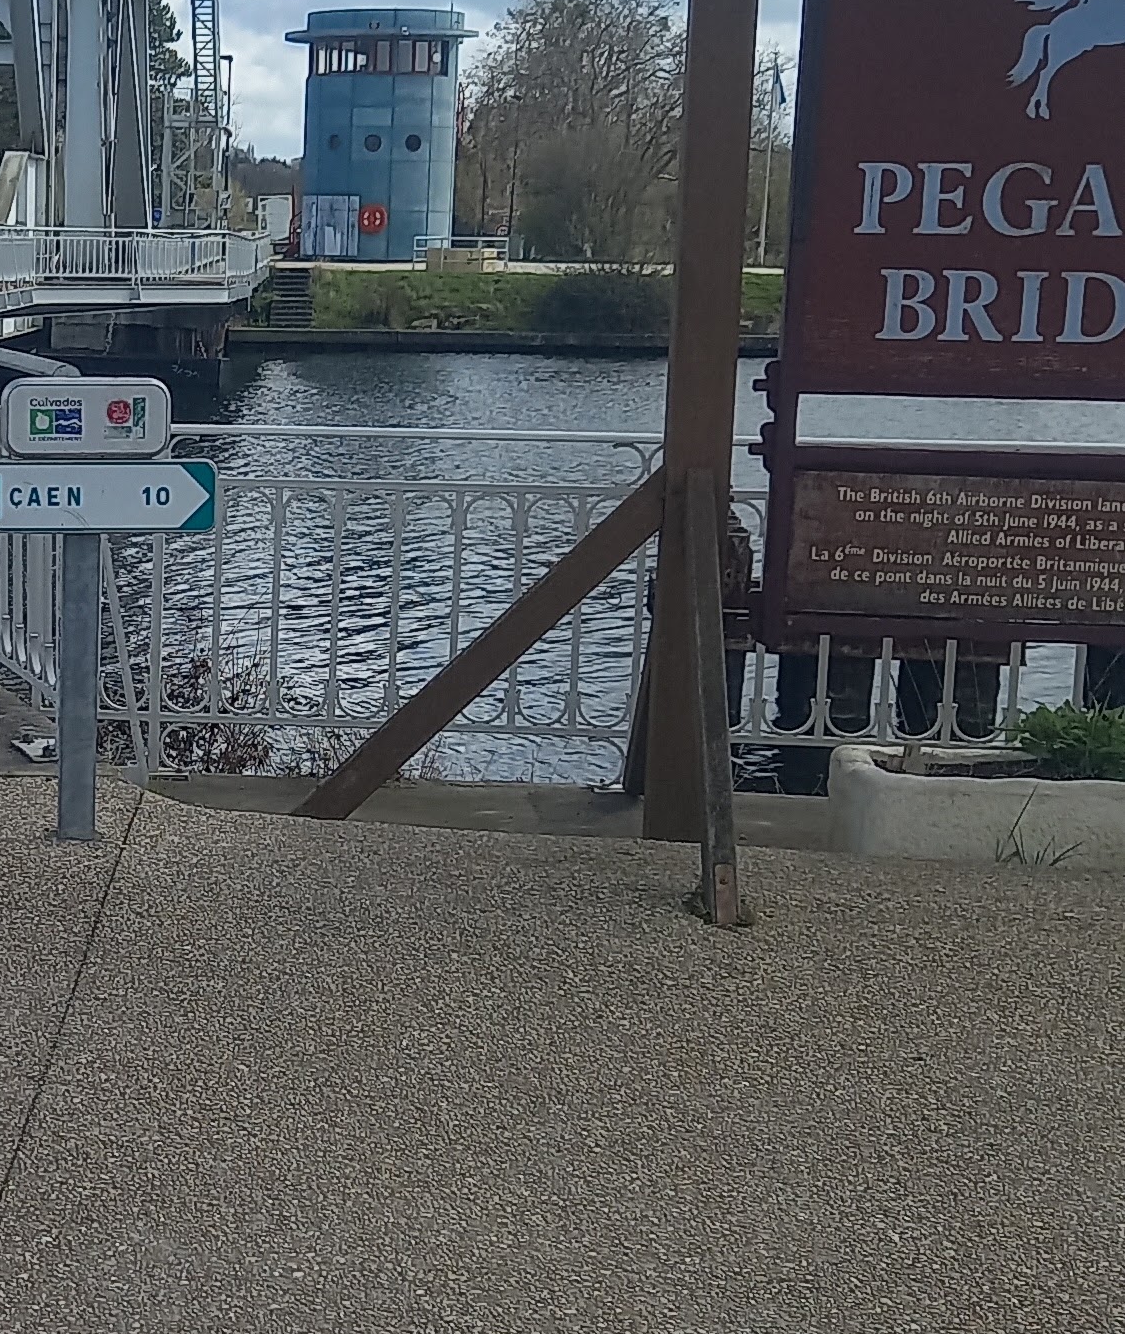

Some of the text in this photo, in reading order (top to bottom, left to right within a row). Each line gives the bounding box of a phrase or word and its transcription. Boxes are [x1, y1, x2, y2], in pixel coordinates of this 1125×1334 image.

[853, 162, 1123, 236] PEGA
[874, 269, 1125, 343] BRID
[29, 397, 83, 407] Calvados
[9, 486, 171, 507] CAEN 10
[837, 486, 865, 502] The
[870, 488, 921, 504] British
[926, 490, 952, 505] 6th
[956, 491, 1025, 508] Airborne
[1030, 495, 1092, 511] Division
[855, 510, 874, 522] on
[879, 508, 905, 523] the
[910, 509, 950, 528] night
[954, 510, 972, 525] of
[974, 511, 999, 526] 5th
[1002, 513, 1038, 531] June
[1043, 513, 1080, 532] 1944,
[1085, 520, 1104, 531] as
[1108, 521, 1118, 532] a
[947, 530, 1125, 551] Allied Armies of Libera
[811, 546, 829, 561] La
[872, 549, 933, 565] Division
[942, 552, 1031, 570] Aéroportée
[1036, 555, 1125, 577] Britannique
[830, 566, 849, 580] de
[854, 570, 870, 581] ce
[874, 571, 912, 585] pont
[916, 570, 953, 585] dans
[958, 572, 972, 586] la
[976, 573, 1008, 587] nuit
[1012, 574, 1032, 588] du
[1037, 575, 1047, 589] 5
[1086, 577, 1124, 595] 1944,
[919, 589, 1125, 612] des Armées Alliées de Libé
